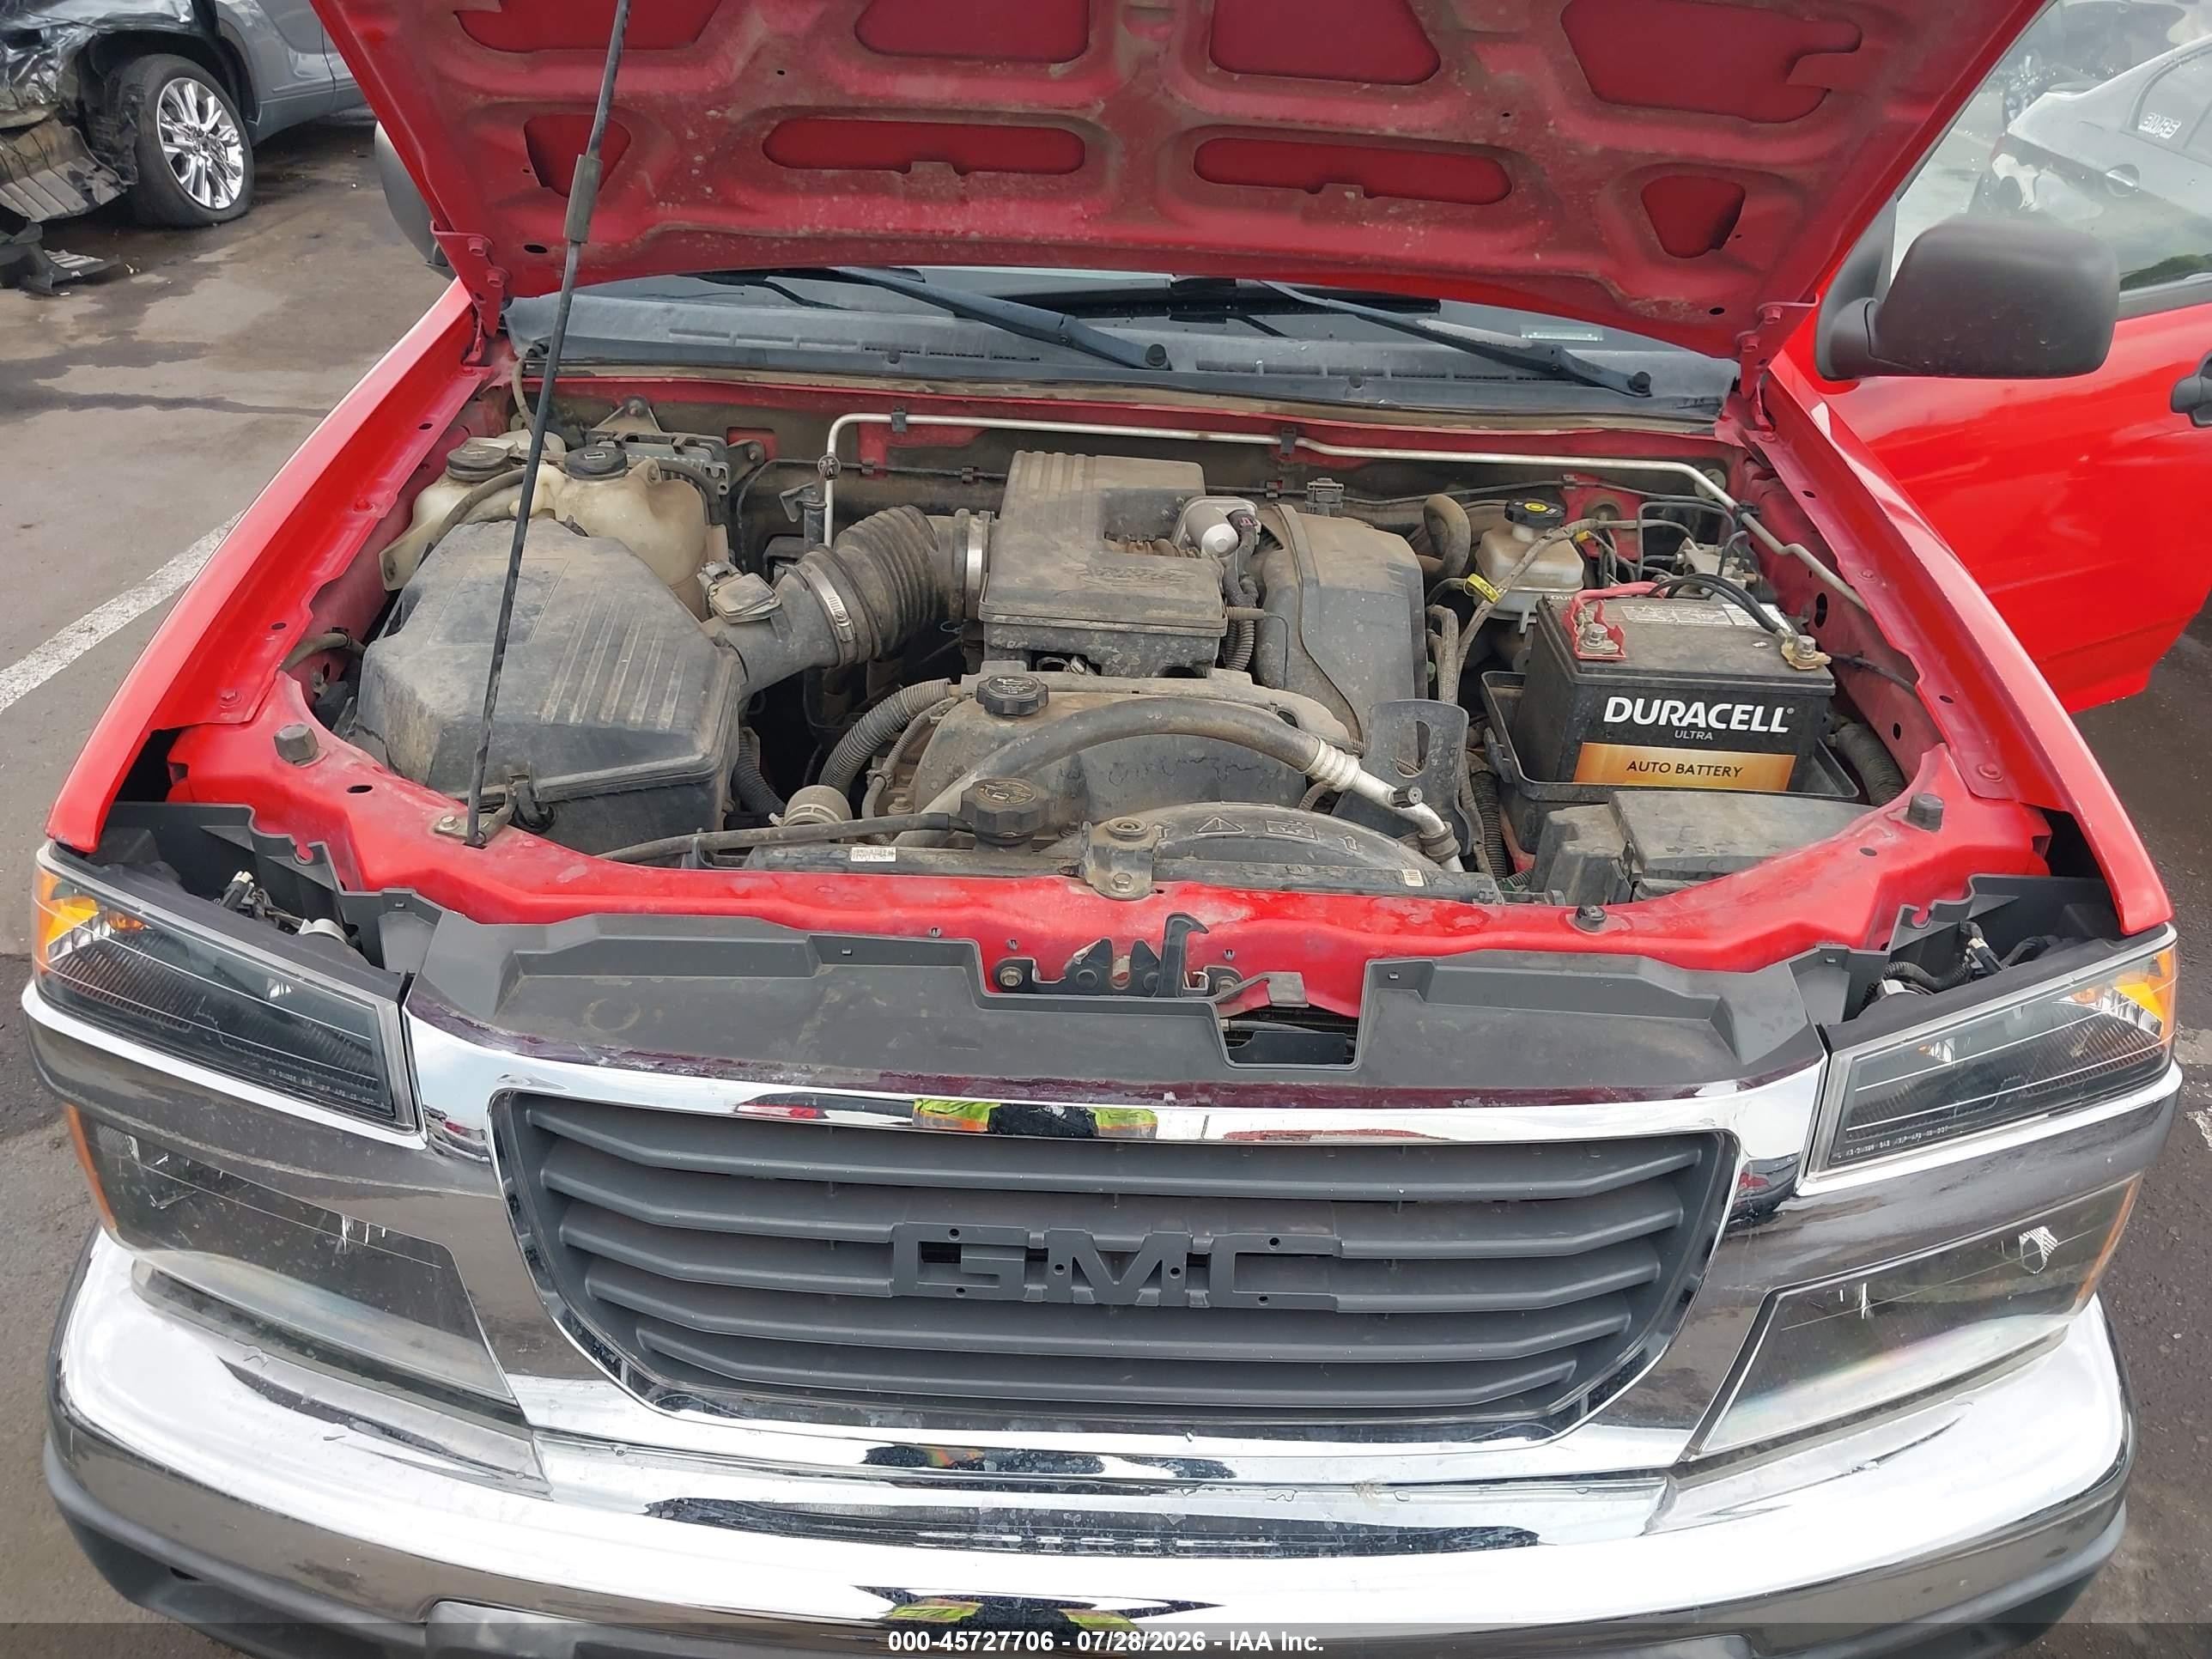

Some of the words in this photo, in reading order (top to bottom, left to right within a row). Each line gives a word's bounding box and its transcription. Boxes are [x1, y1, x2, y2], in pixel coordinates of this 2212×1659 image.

[1603, 696, 1790, 733] DURACELL
[1674, 729, 1713, 741] ULTRA
[1626, 760, 1671, 774] AUTO
[1675, 763, 1744, 778] BATTERY
[893, 1221, 1337, 1311] GMC
